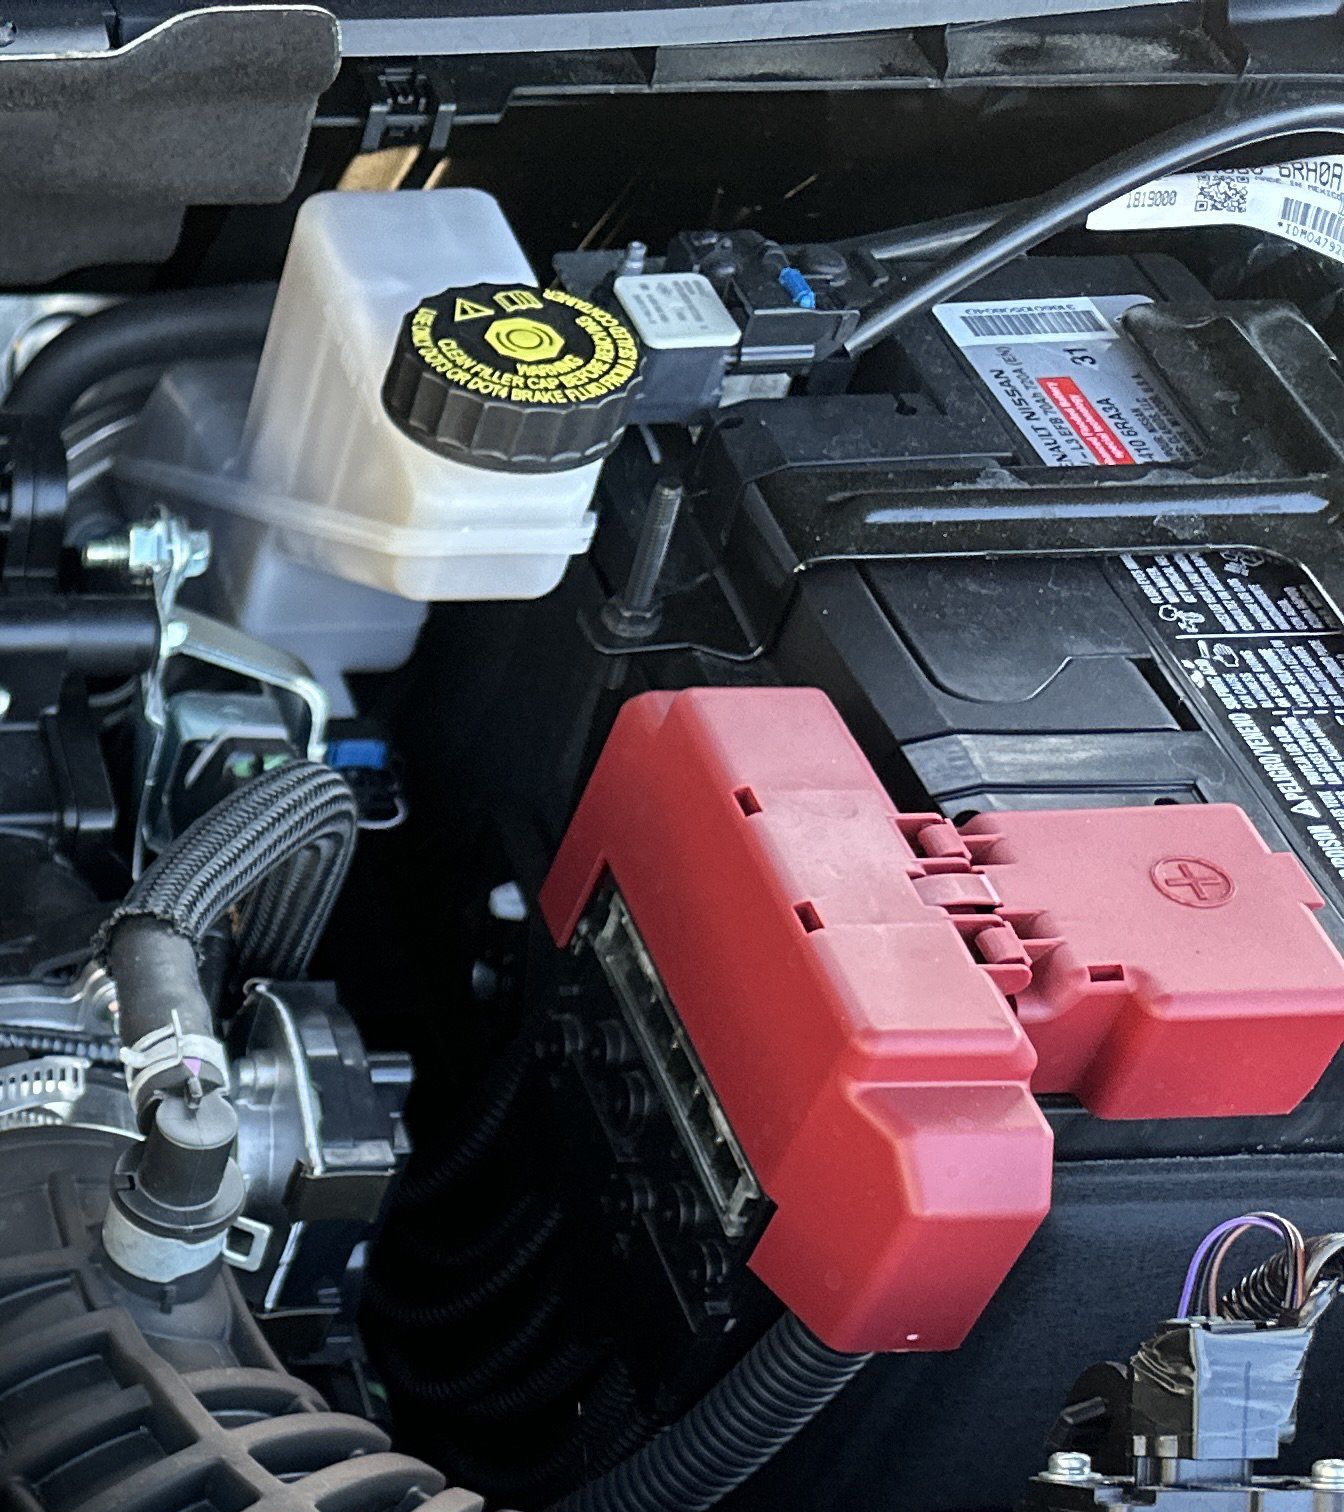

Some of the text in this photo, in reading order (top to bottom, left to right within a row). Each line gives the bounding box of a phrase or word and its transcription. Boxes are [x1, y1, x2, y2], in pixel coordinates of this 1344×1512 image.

[1060, 347, 1099, 365] 31
[467, 376, 510, 399] DOT4
[511, 387, 568, 403] BRAKE
[470, 363, 526, 389] FILLER
[527, 377, 560, 390] CAP
[987, 368, 1042, 421] NISSAN
[1228, 713, 1308, 801] PELIGRO/VENENO
